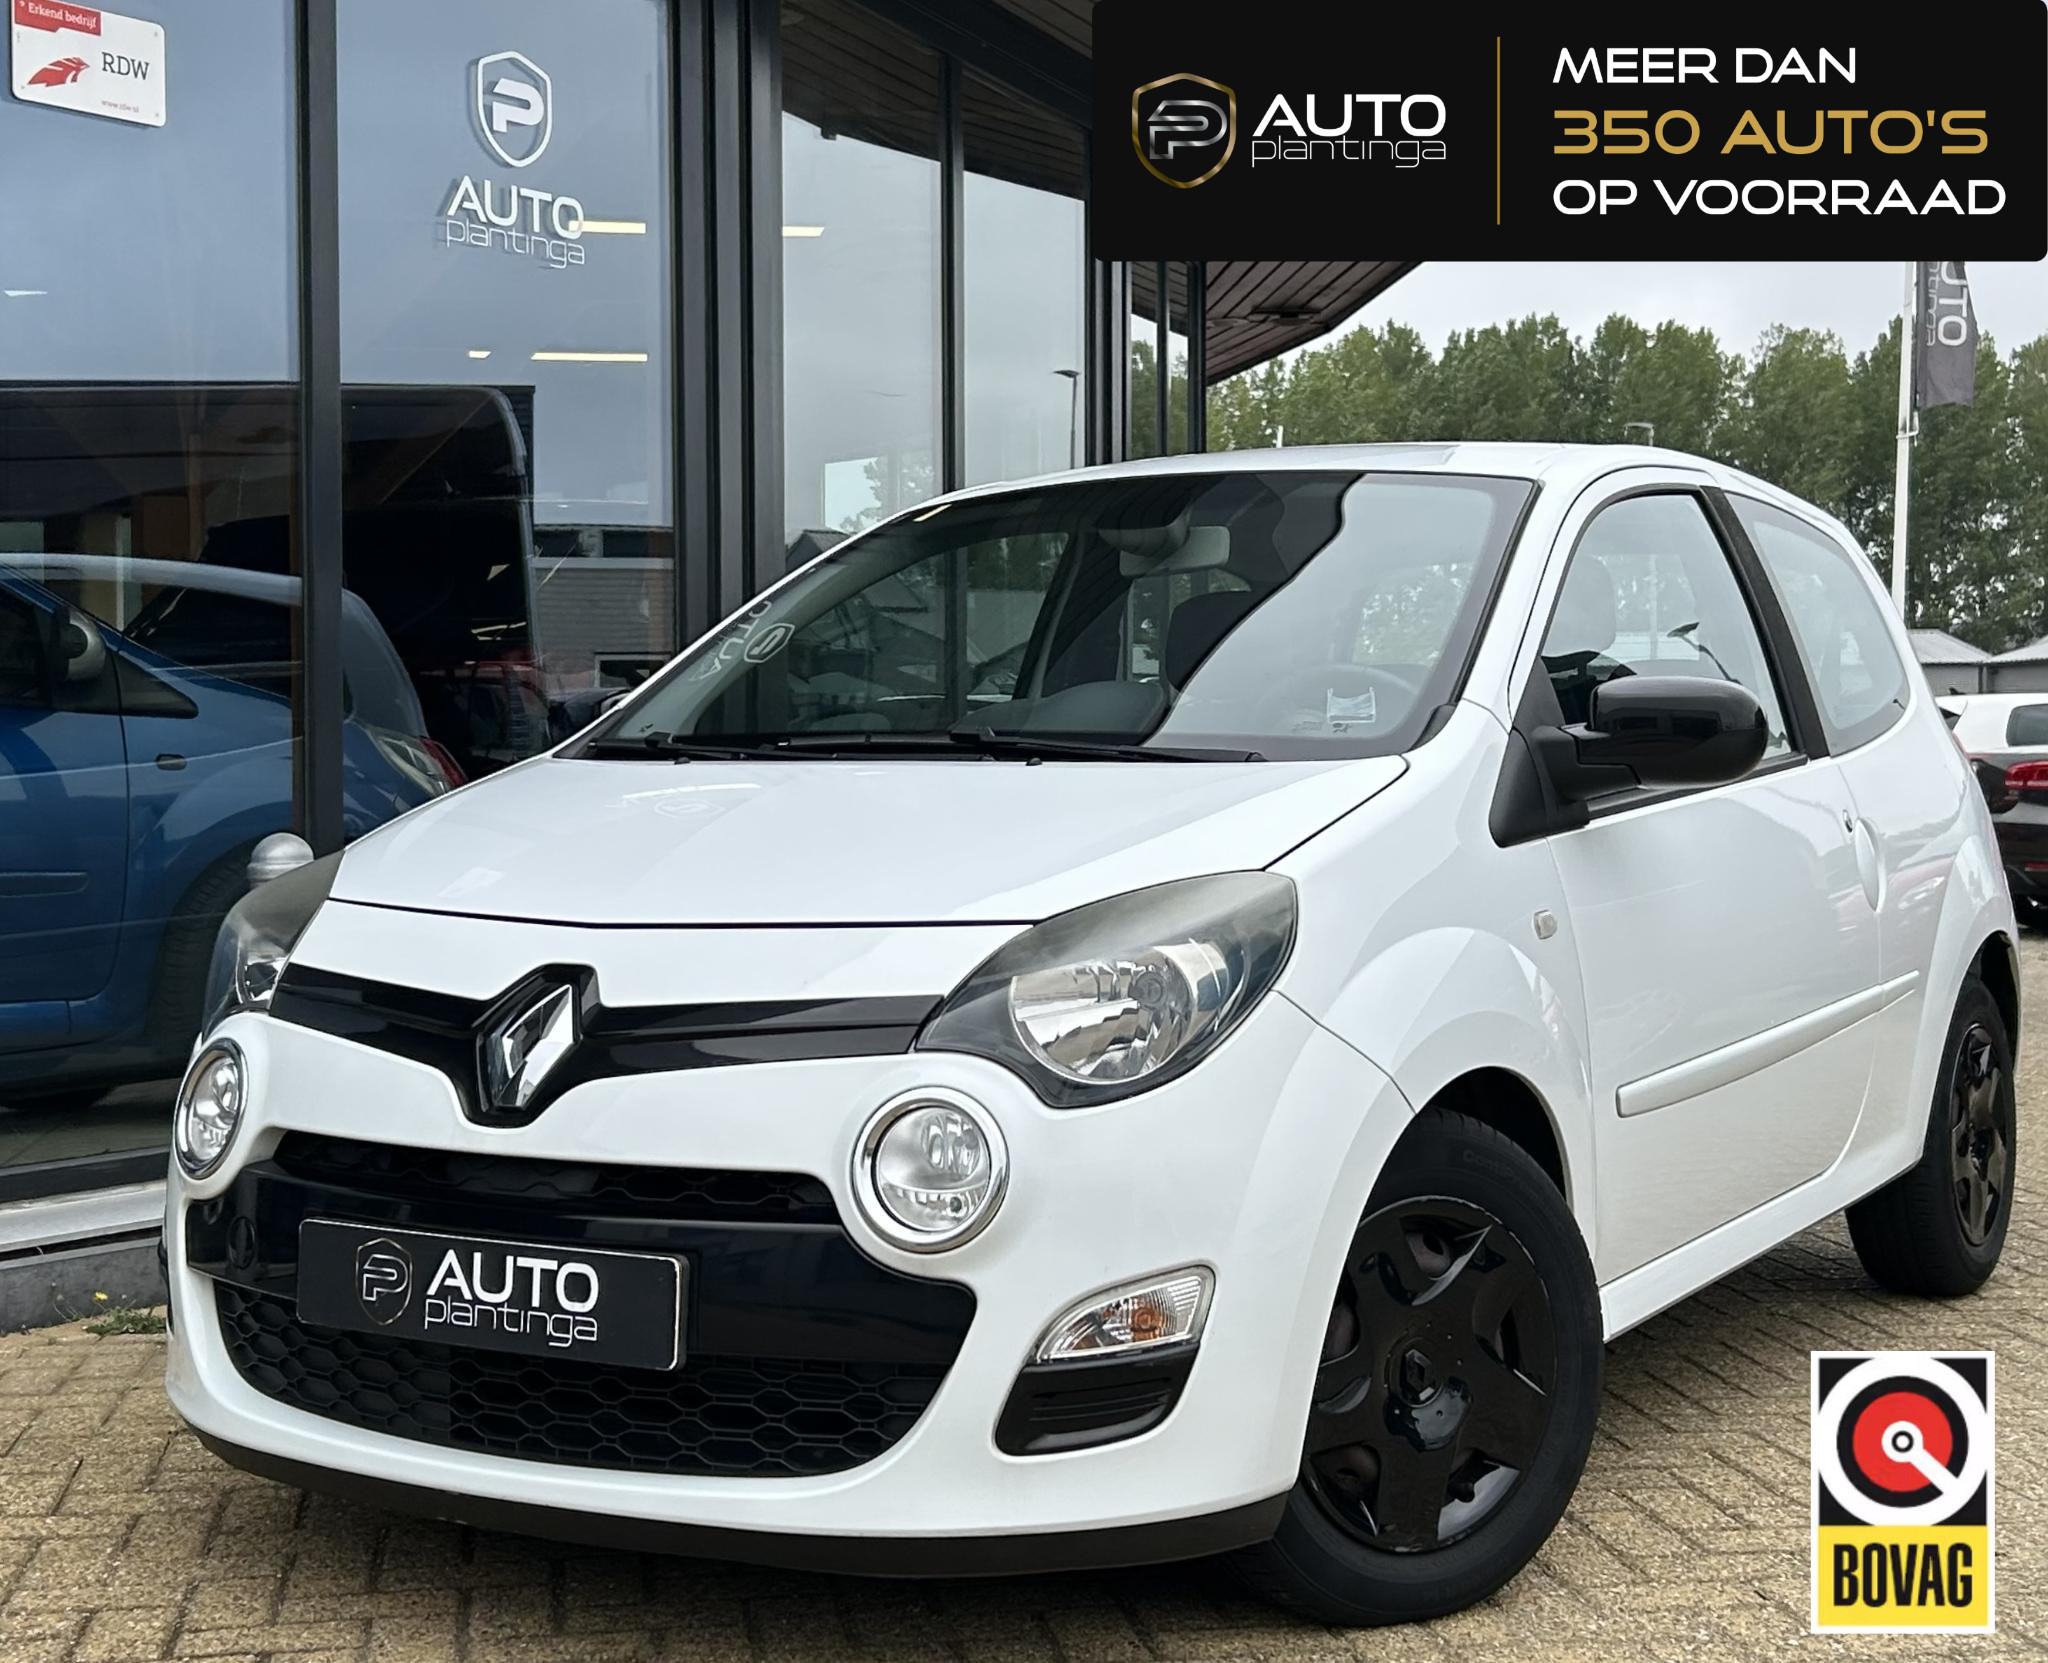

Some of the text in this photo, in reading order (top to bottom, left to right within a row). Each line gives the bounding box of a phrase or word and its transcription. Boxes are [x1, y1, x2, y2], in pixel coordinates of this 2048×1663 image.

[28, 2, 97, 29] Erkend bedrijf
[101, 51, 149, 80] RDW
[447, 175, 585, 240] AUTO
[446, 218, 585, 269] plantinga
[1938, 261, 1968, 346] UTO
[426, 1249, 599, 1313] AUTO
[424, 1296, 597, 1348] plantinga
